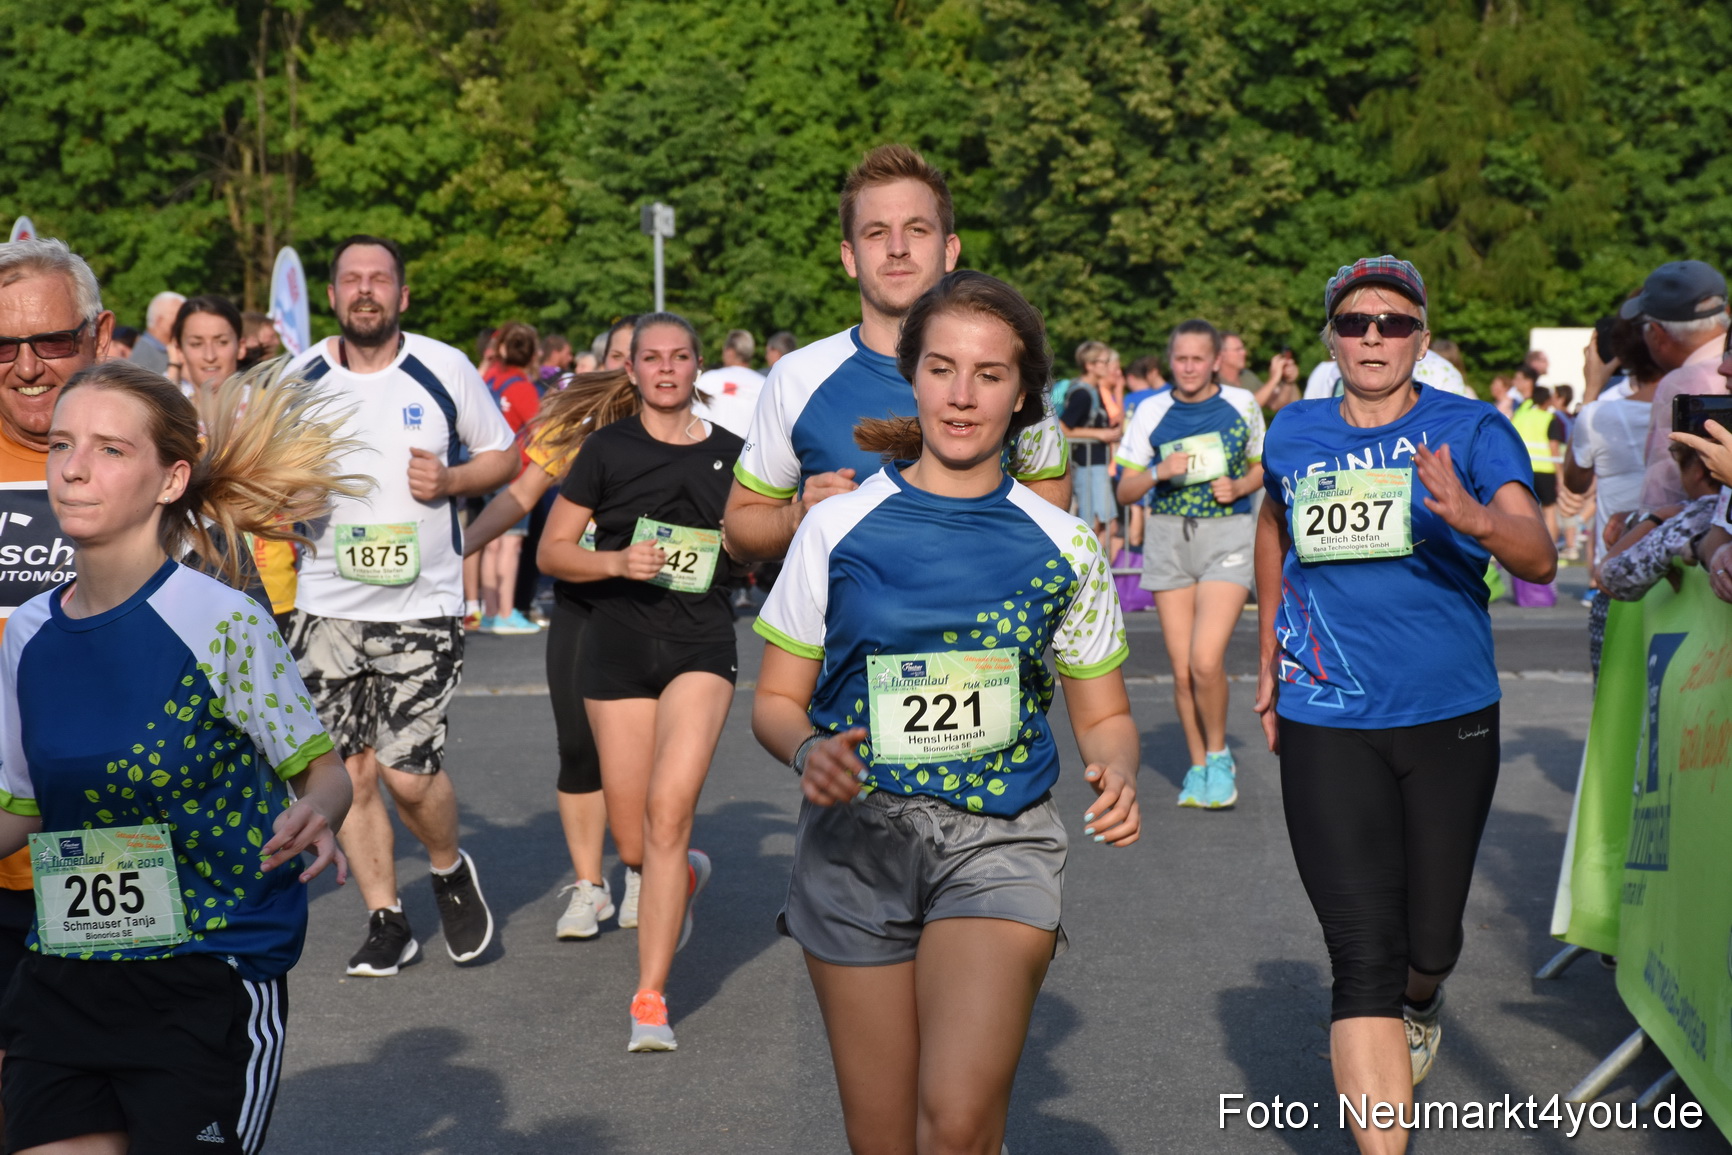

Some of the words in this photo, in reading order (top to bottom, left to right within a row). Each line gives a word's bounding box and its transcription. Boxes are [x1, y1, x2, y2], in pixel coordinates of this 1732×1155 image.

[1310, 486, 1353, 499] firmenlauf
[1380, 490, 1402, 498] 2019
[1306, 500, 1394, 536] 2037
[1320, 535, 1348, 544] Ellrich
[1351, 534, 1380, 543] Stefan
[1328, 543, 1368, 552] Technologies
[346, 545, 408, 567] 1875
[660, 547, 698, 574] 42
[891, 674, 950, 687] firmenlauf
[984, 676, 1010, 688] 2019
[903, 690, 981, 732] 221
[908, 734, 940, 744] Hensl
[944, 729, 986, 743] Hannah
[923, 744, 960, 753] Bionorica
[52, 852, 104, 868] firmenlauf
[138, 858, 164, 869] 2019
[64, 871, 145, 918] 265
[63, 918, 122, 932] Schmauser
[124, 915, 156, 928] Tanja
[86, 931, 120, 940] Bionorica
[122, 929, 133, 938] SE
[196, 1134, 225, 1144] adidas
